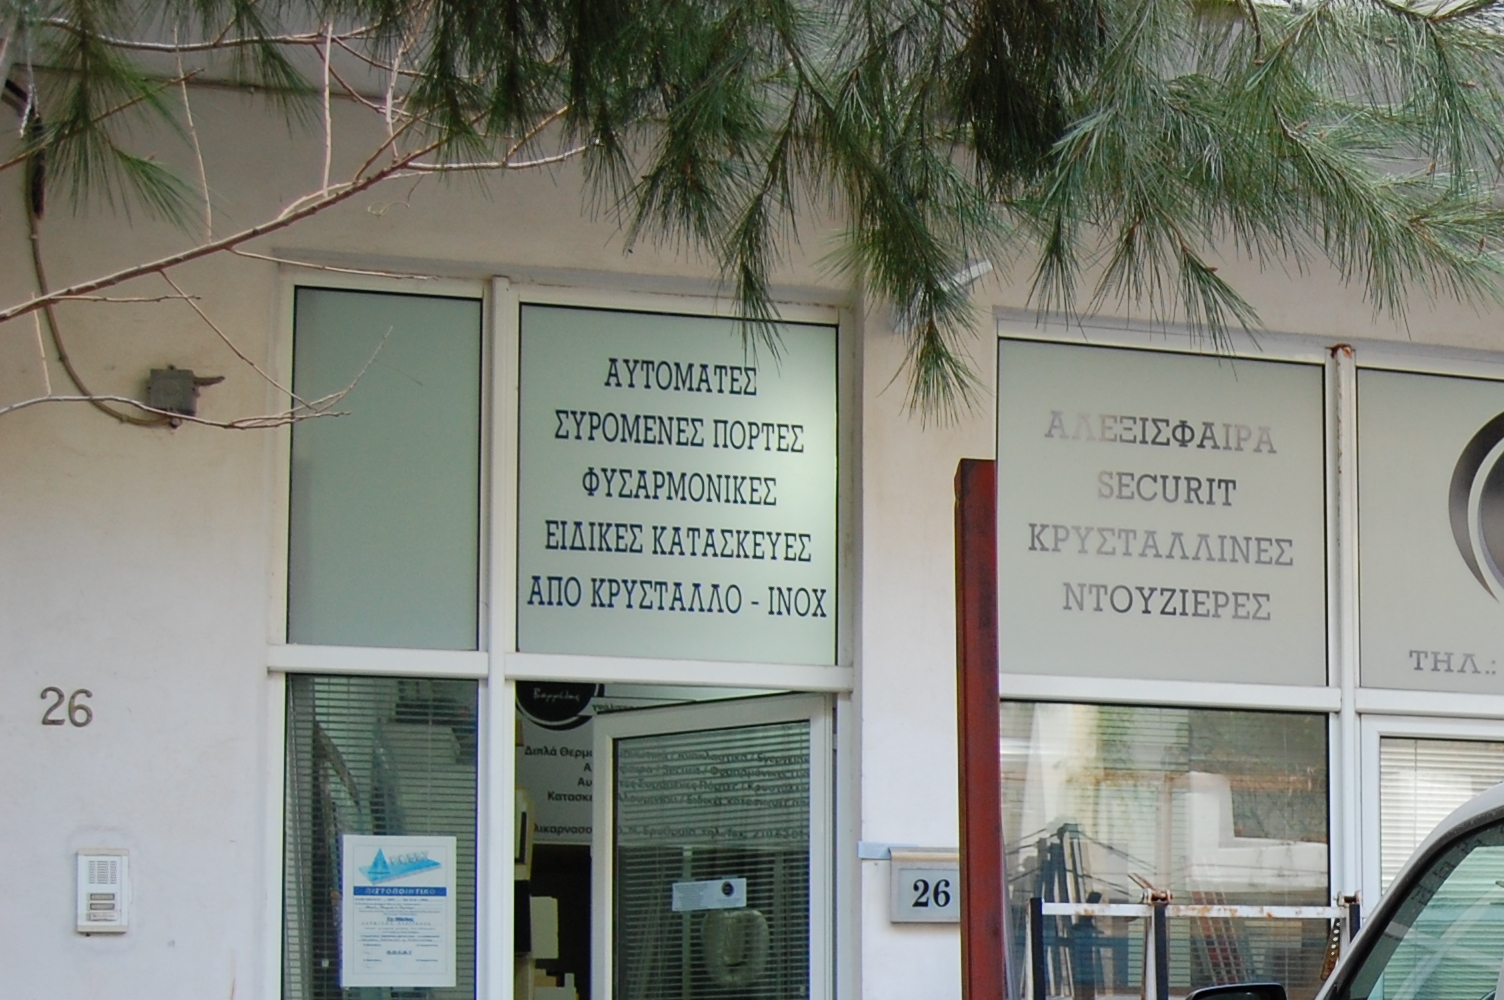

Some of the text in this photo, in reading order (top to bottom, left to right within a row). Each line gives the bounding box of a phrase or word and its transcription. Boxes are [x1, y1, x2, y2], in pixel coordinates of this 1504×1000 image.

[604, 357, 757, 396] ΑΥΤΟΜΑΤΕΣ
[555, 409, 804, 453] ΣΥΡΟΜΕΝΕΣ ΠΟΡΤΕΣ
[1044, 409, 1277, 454] ΑΛΕΞΙΣΦΑΙΡΑ
[582, 466, 777, 506] ΦΥΣΑΡΜΟΝΙΚΕΣ
[1098, 470, 1237, 507] SECURIT
[545, 520, 812, 563] ΕΙΔΙΚΕΣ ΚΑΤΑΣΚΕΥΕΣ
[1028, 523, 1294, 566] ΚΡΥΣΤΑΛΛΙΝΕΣ
[527, 575, 582, 607] ΑΠΟ
[591, 578, 742, 614] ΚΡΥΣΤΑΛΛΟ
[1063, 582, 1271, 621] ΝΤΟΥΖΙΕΡΕΣ
[40, 686, 93, 727] 26
[912, 879, 950, 907] 26
